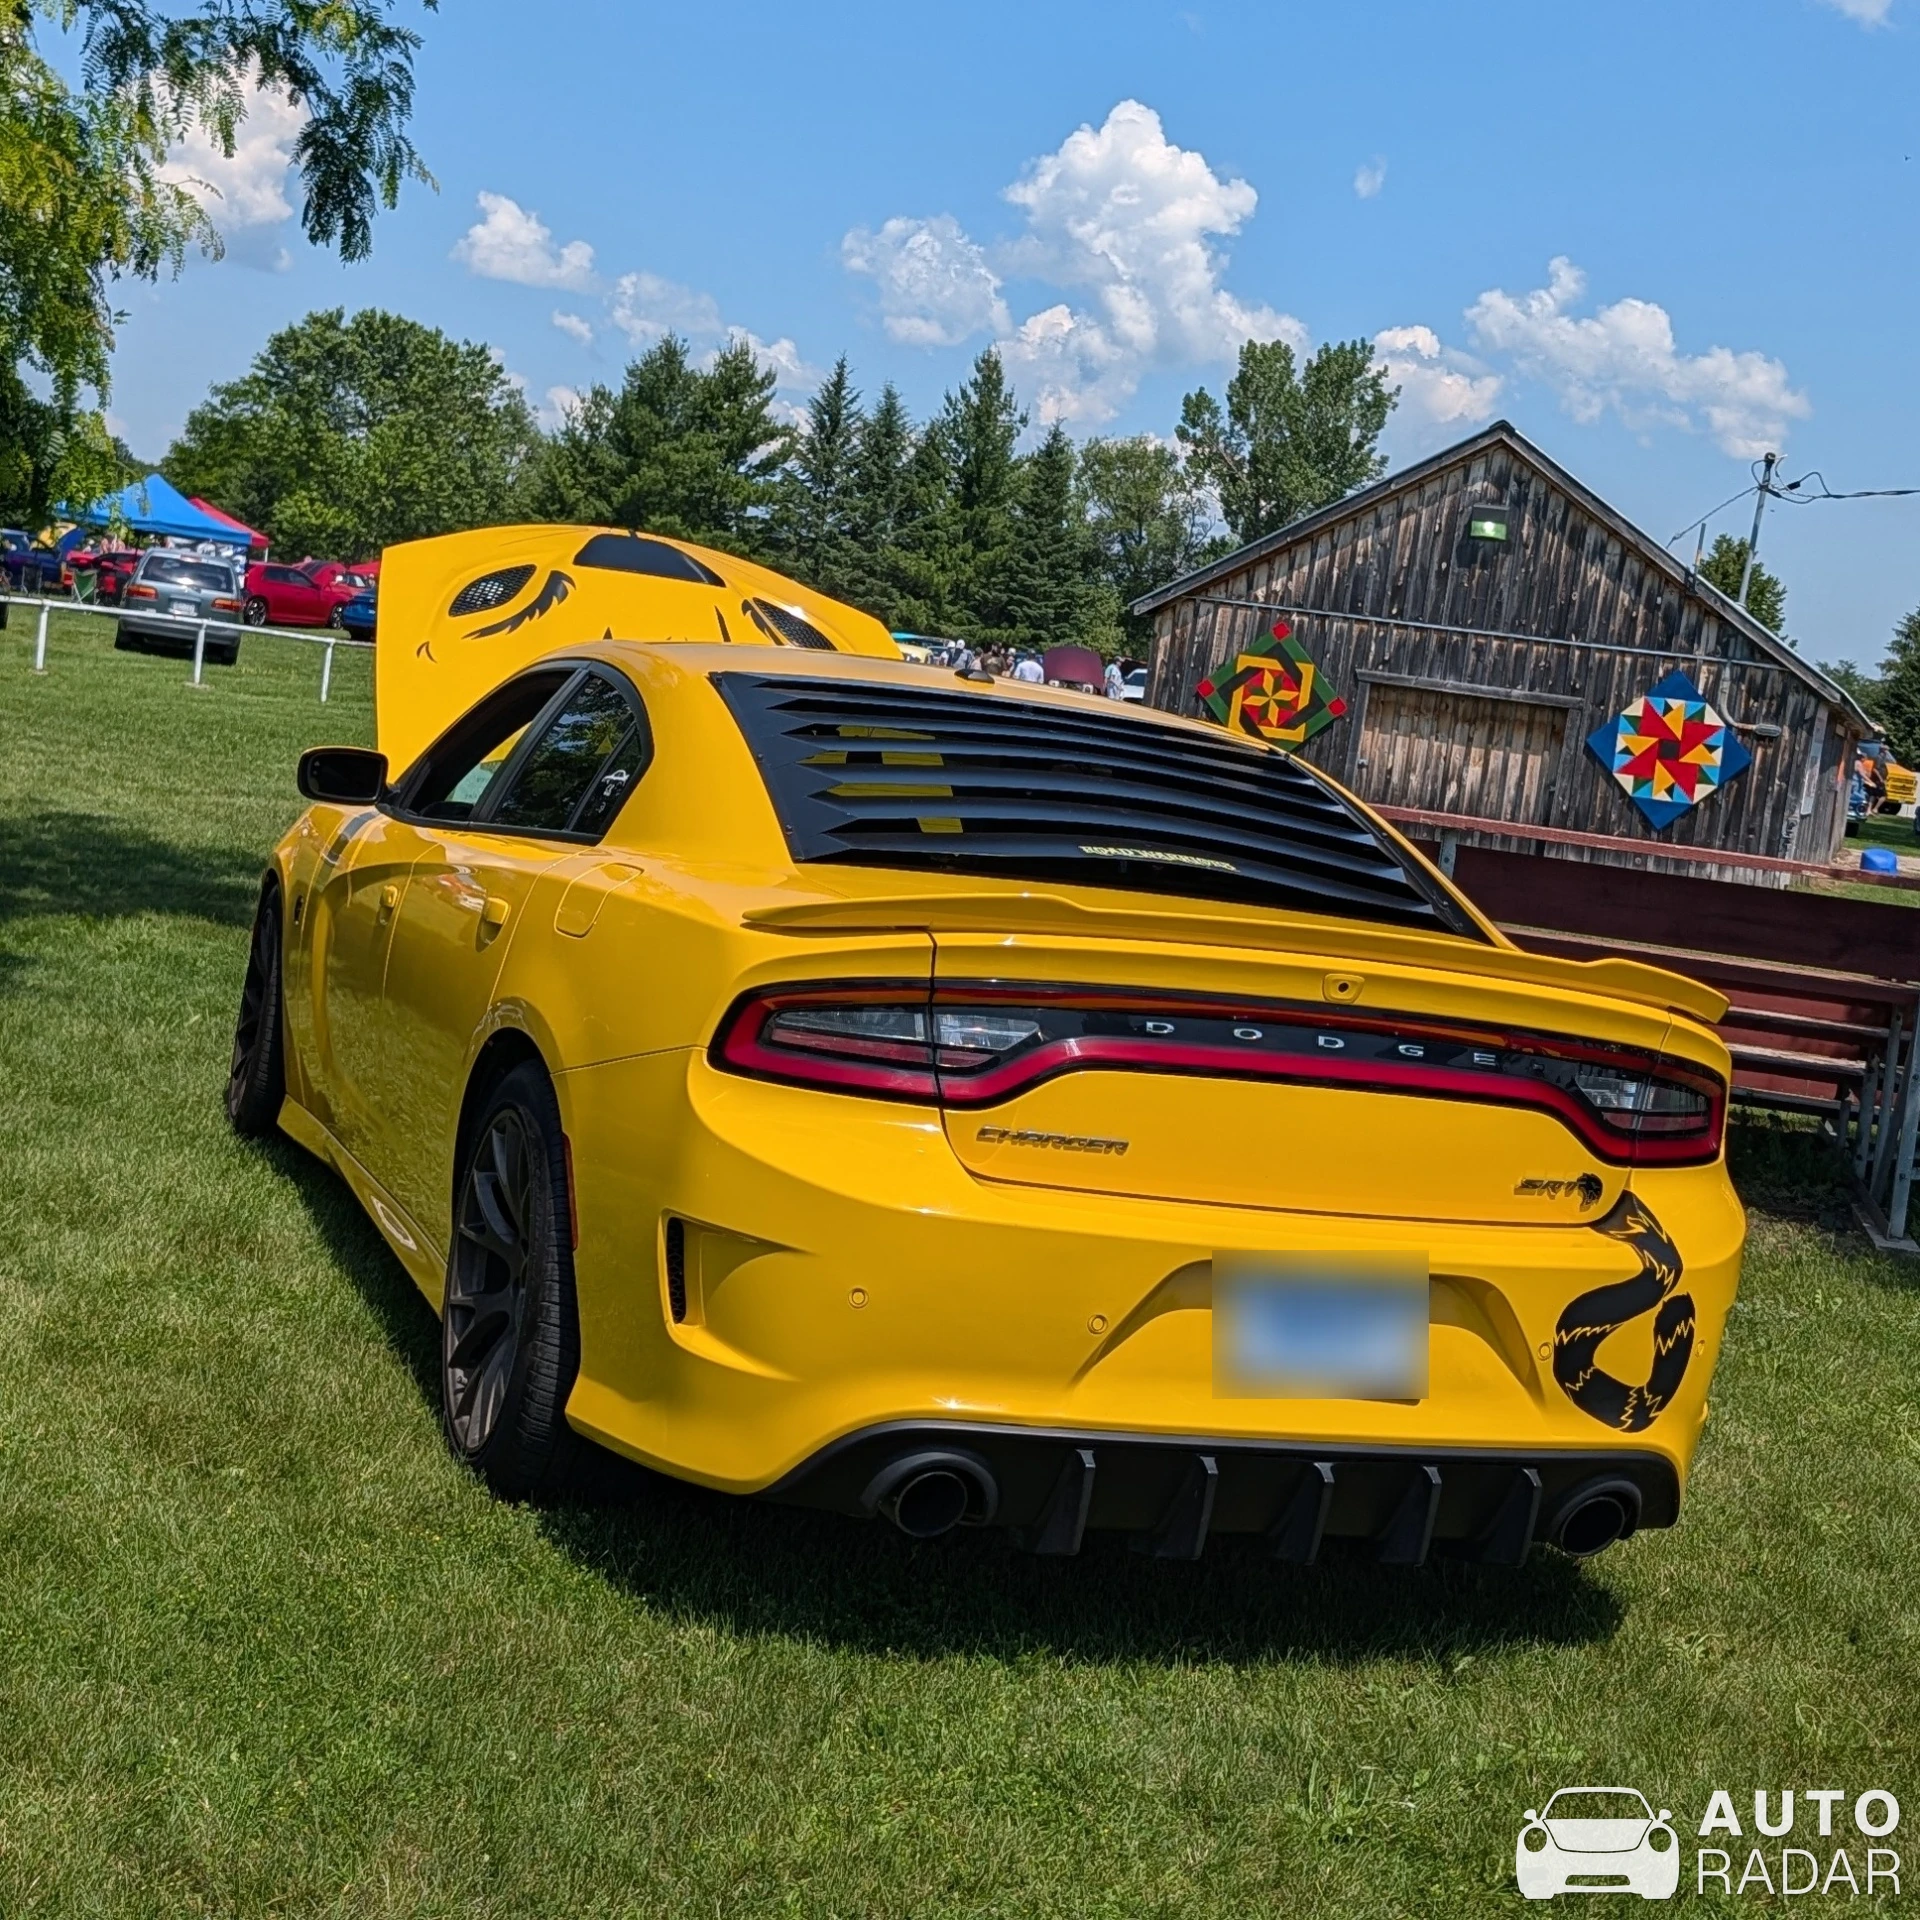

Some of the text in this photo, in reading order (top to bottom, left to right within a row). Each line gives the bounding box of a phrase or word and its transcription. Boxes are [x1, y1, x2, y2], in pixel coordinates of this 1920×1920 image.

[1146, 1021, 1496, 1066] DODGE
[977, 1126, 1129, 1155] CHARGER
[1514, 1178, 1578, 1199] SRT
